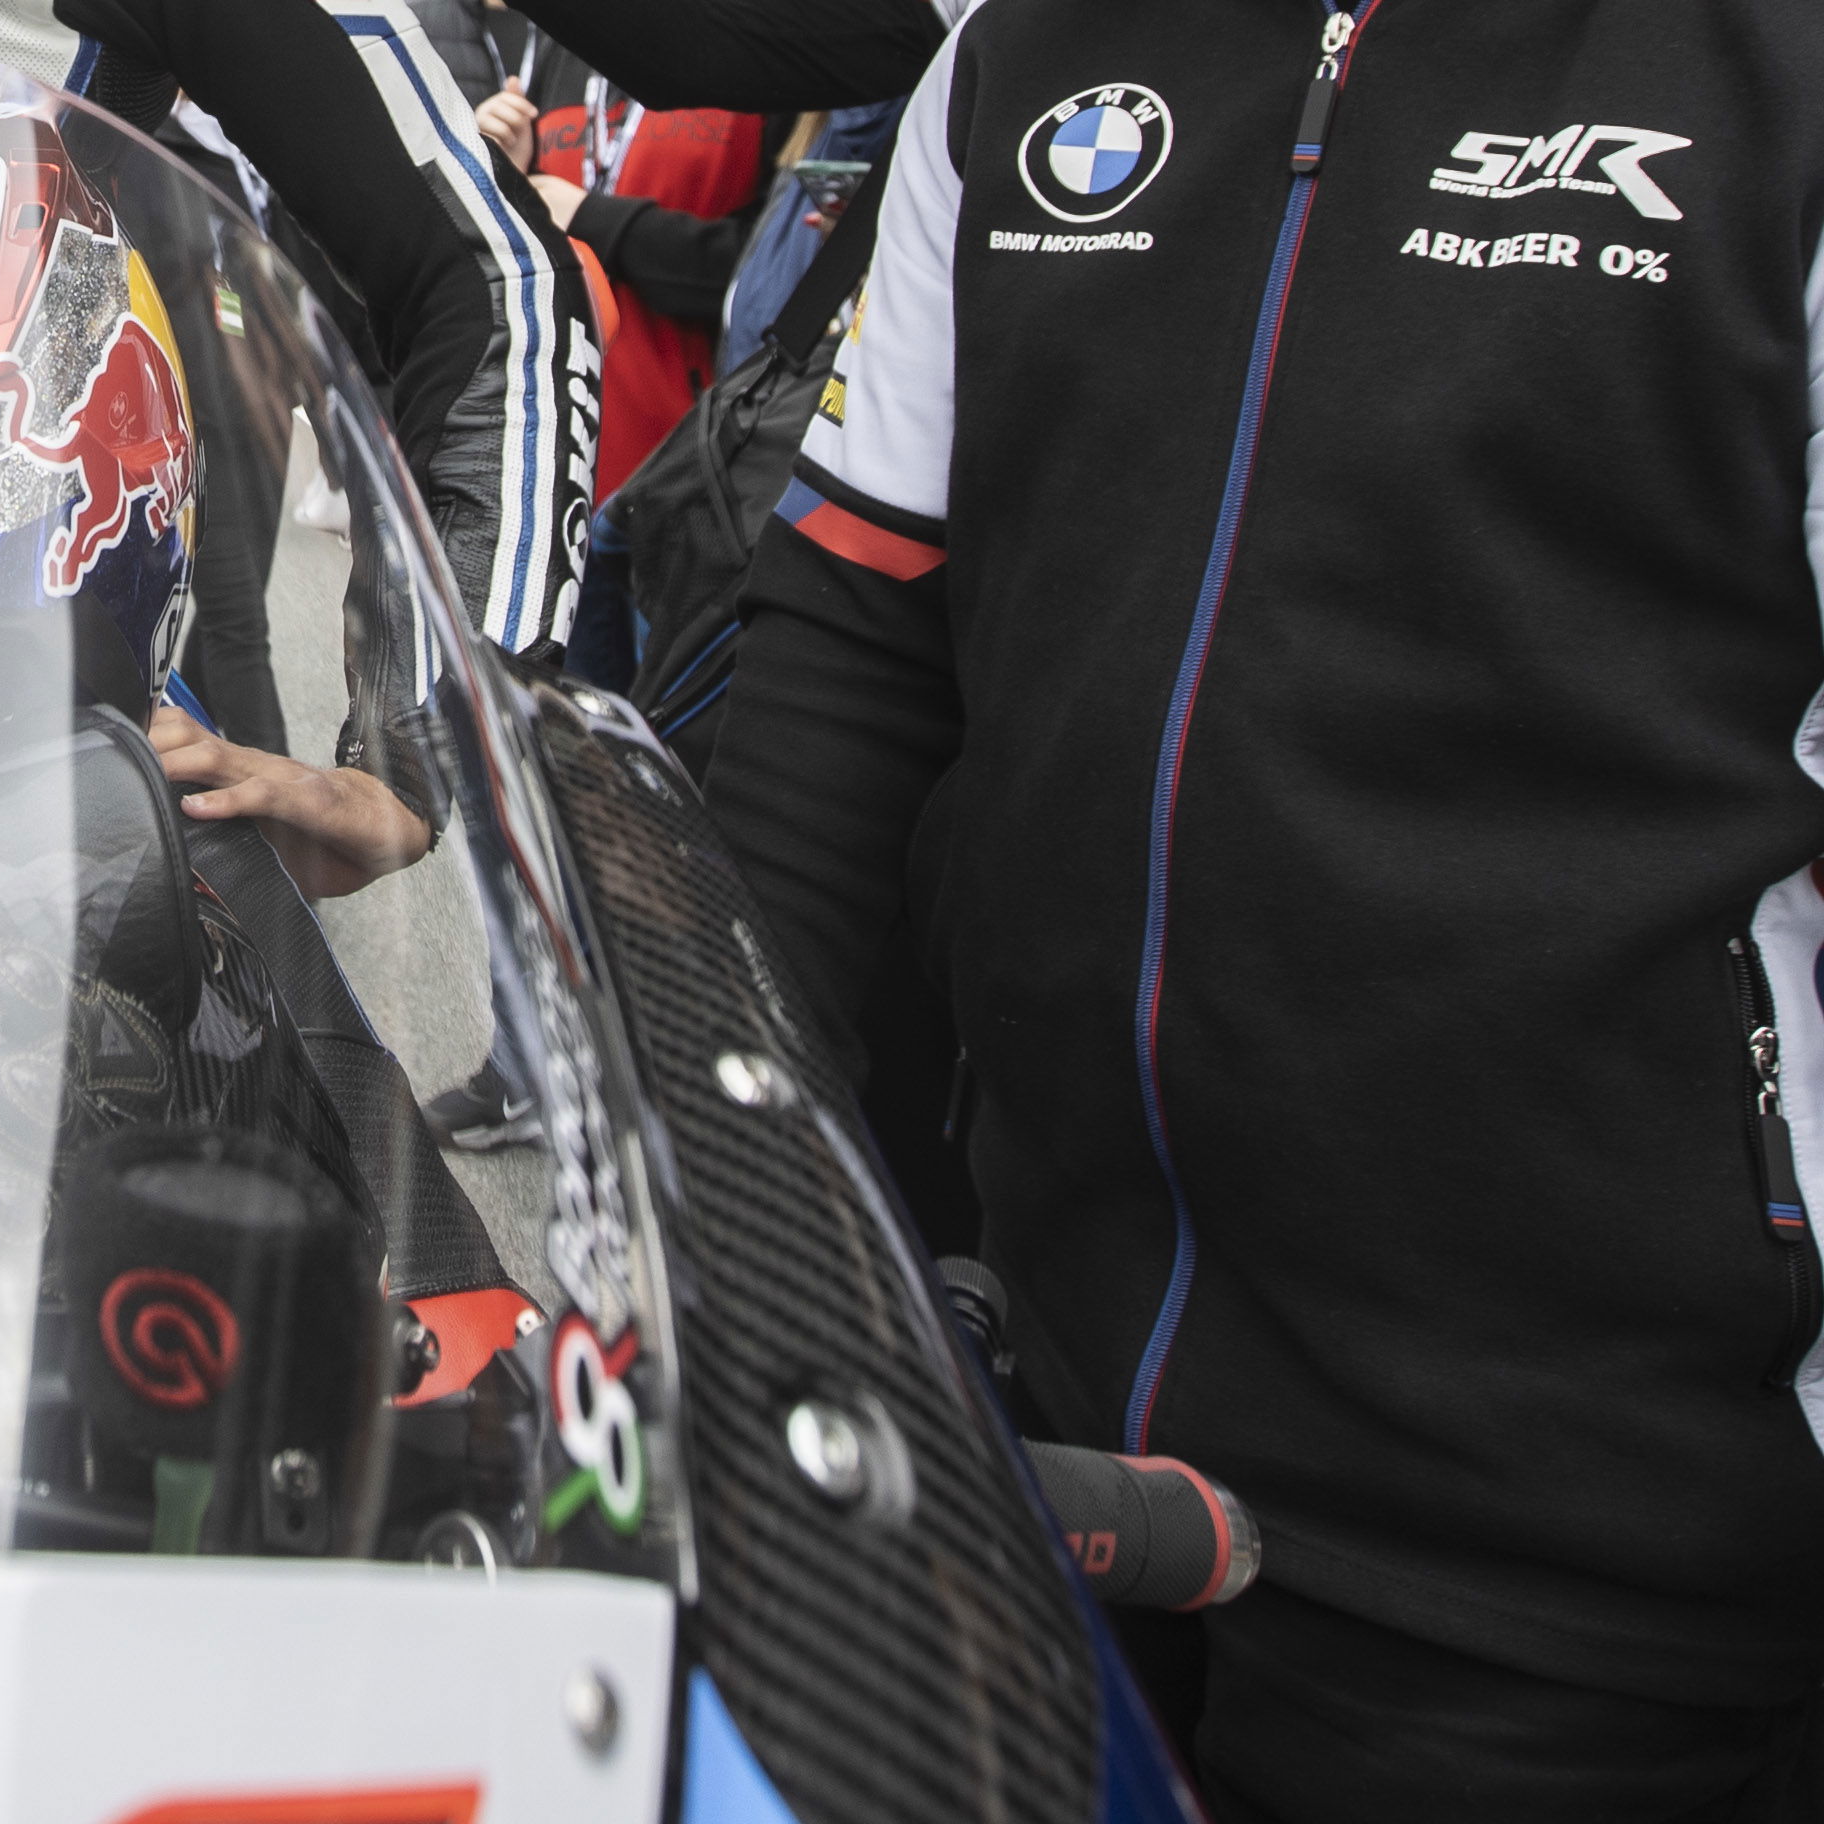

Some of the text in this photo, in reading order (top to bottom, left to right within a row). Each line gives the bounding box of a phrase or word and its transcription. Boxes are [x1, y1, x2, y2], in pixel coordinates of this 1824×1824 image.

[1052, 88, 1160, 126] BMW
[1428, 177, 1489, 198] World
[1557, 176, 1617, 196] Team
[1432, 123, 1694, 221] SMR
[989, 230, 1154, 253] BMW MOTORRAD
[1399, 228, 1671, 284] ABK BEER 0%
